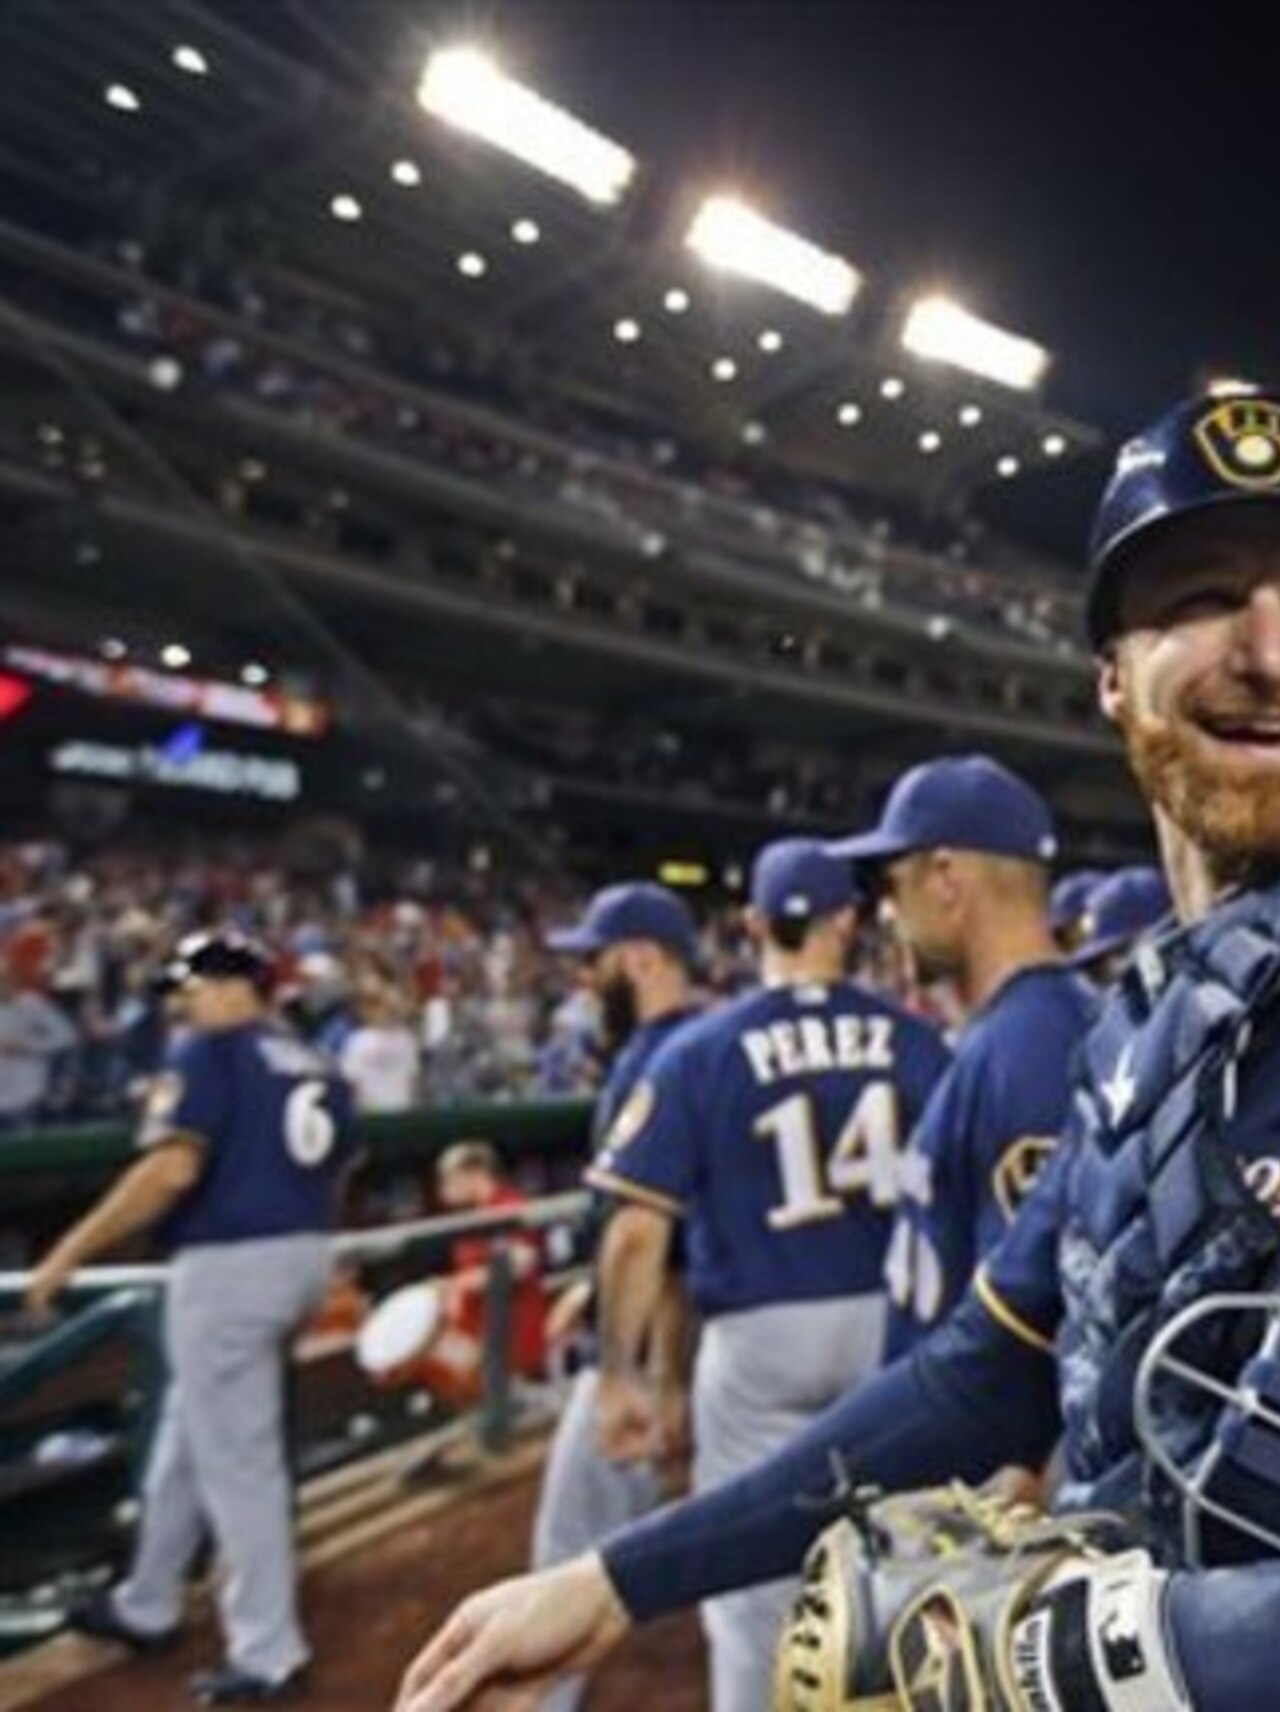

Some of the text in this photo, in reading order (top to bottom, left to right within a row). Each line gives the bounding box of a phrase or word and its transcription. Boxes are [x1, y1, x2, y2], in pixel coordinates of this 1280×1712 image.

[741, 1015, 894, 1084] PEREZ
[284, 1080, 335, 1167] 6
[753, 1080, 902, 1230] 14
